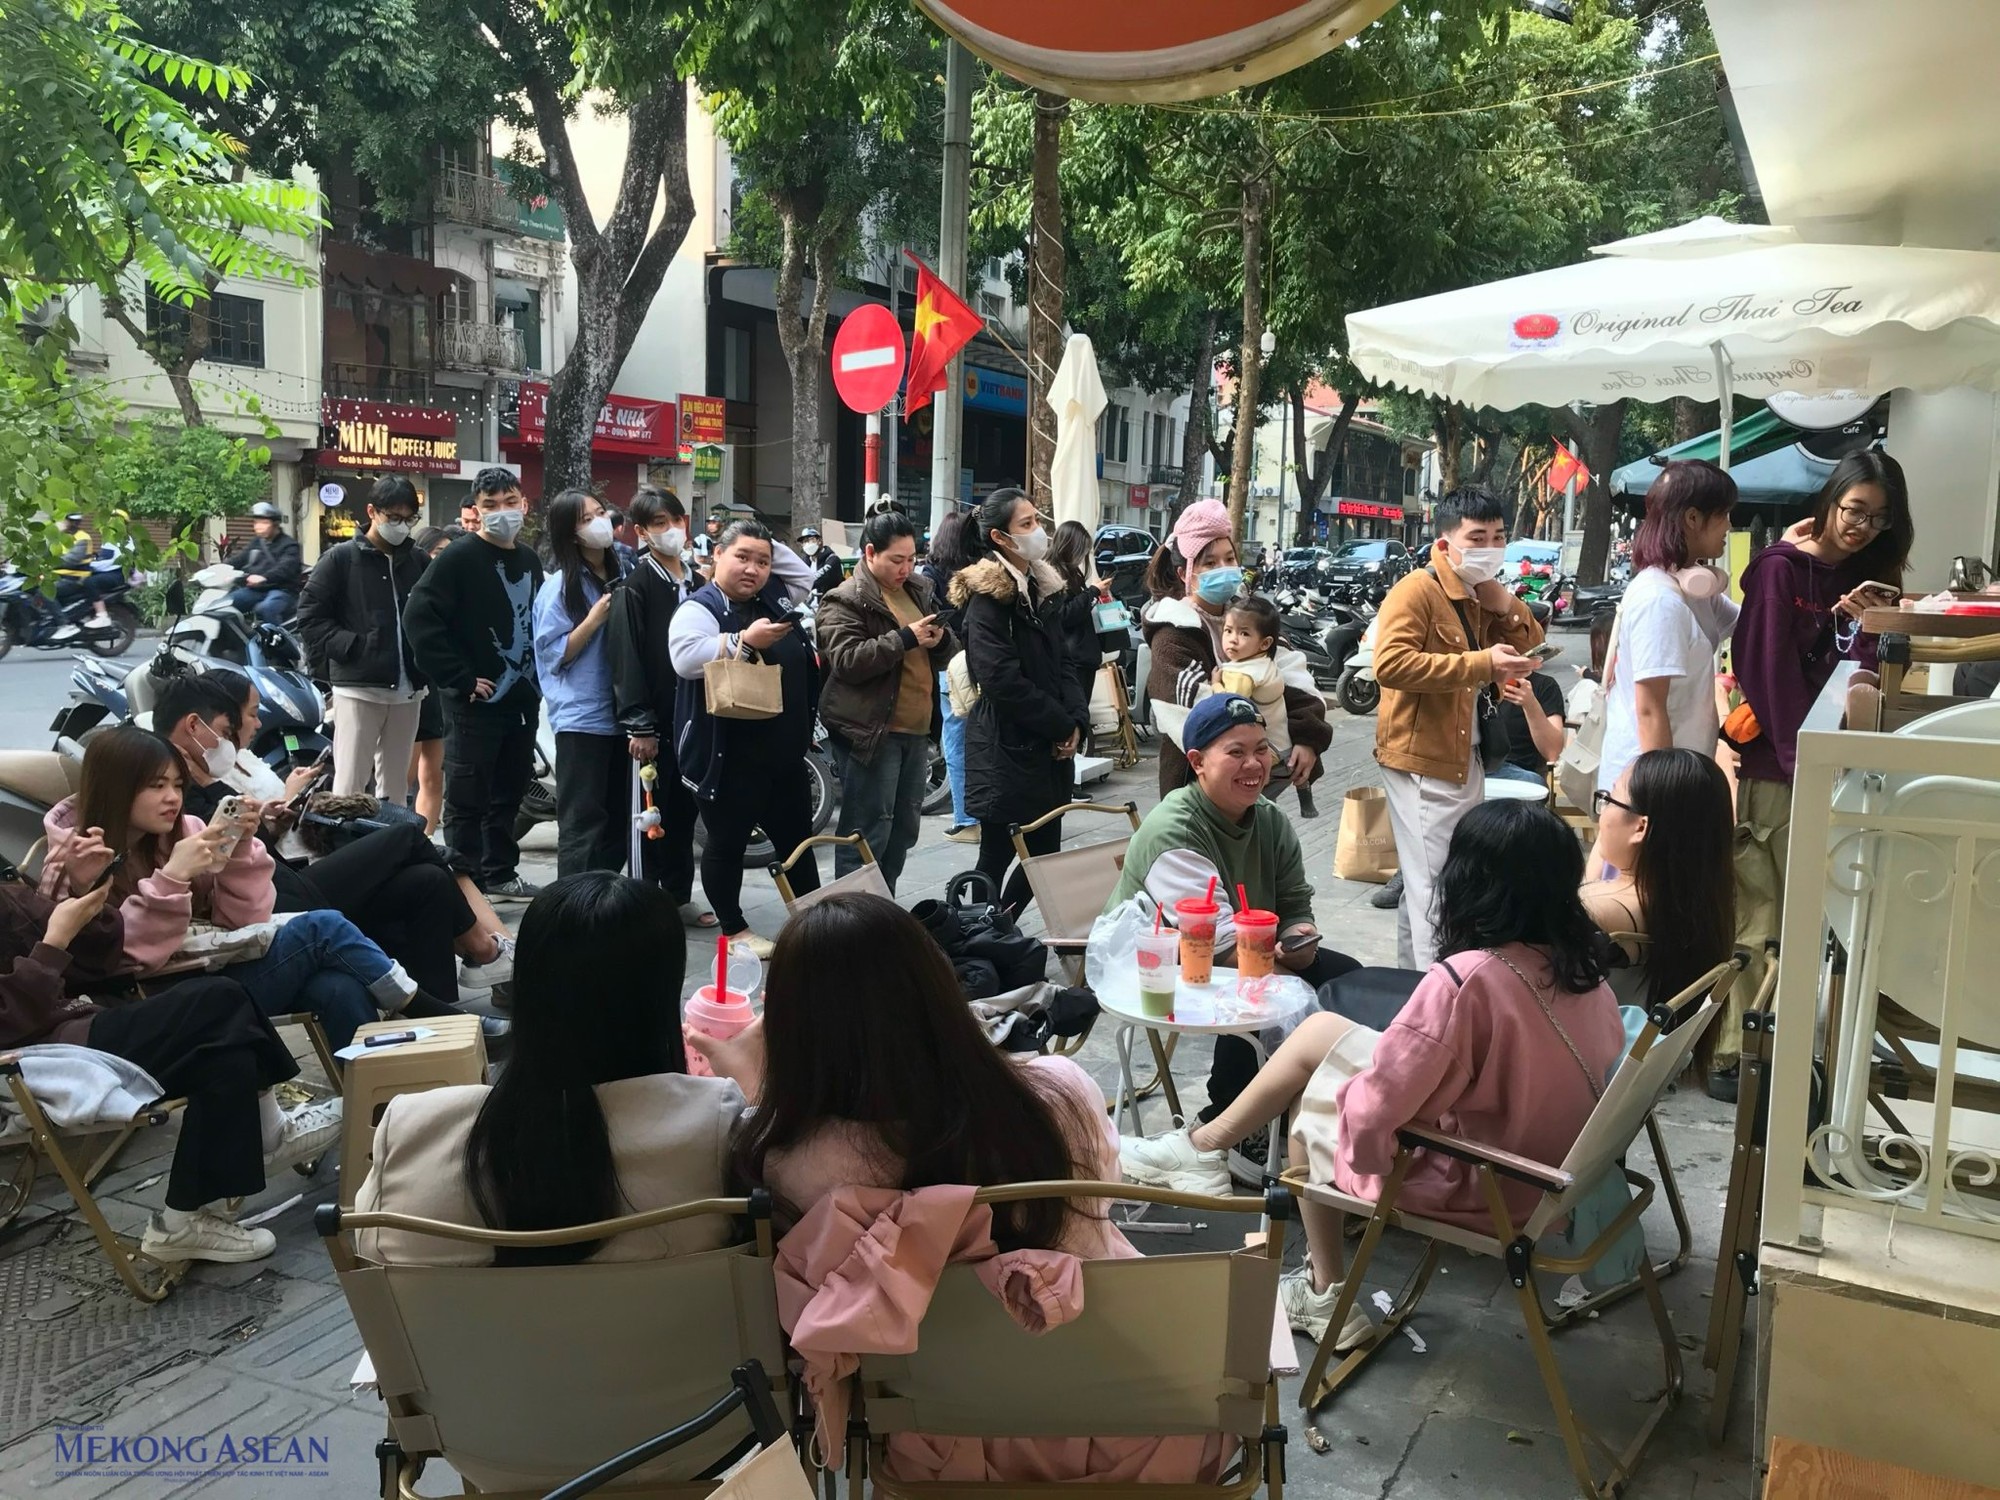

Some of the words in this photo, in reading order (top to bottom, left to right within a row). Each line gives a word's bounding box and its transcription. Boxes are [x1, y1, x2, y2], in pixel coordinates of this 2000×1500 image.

[1570, 303, 1695, 342] Original
[1699, 294, 1784, 322] Thai
[1793, 285, 1864, 315] Tea
[980, 380, 1024, 400] VIETBANK
[1842, 426, 1860, 434] Café
[391, 437, 425, 457] COFFEE
[433, 441, 457, 459] JUICE
